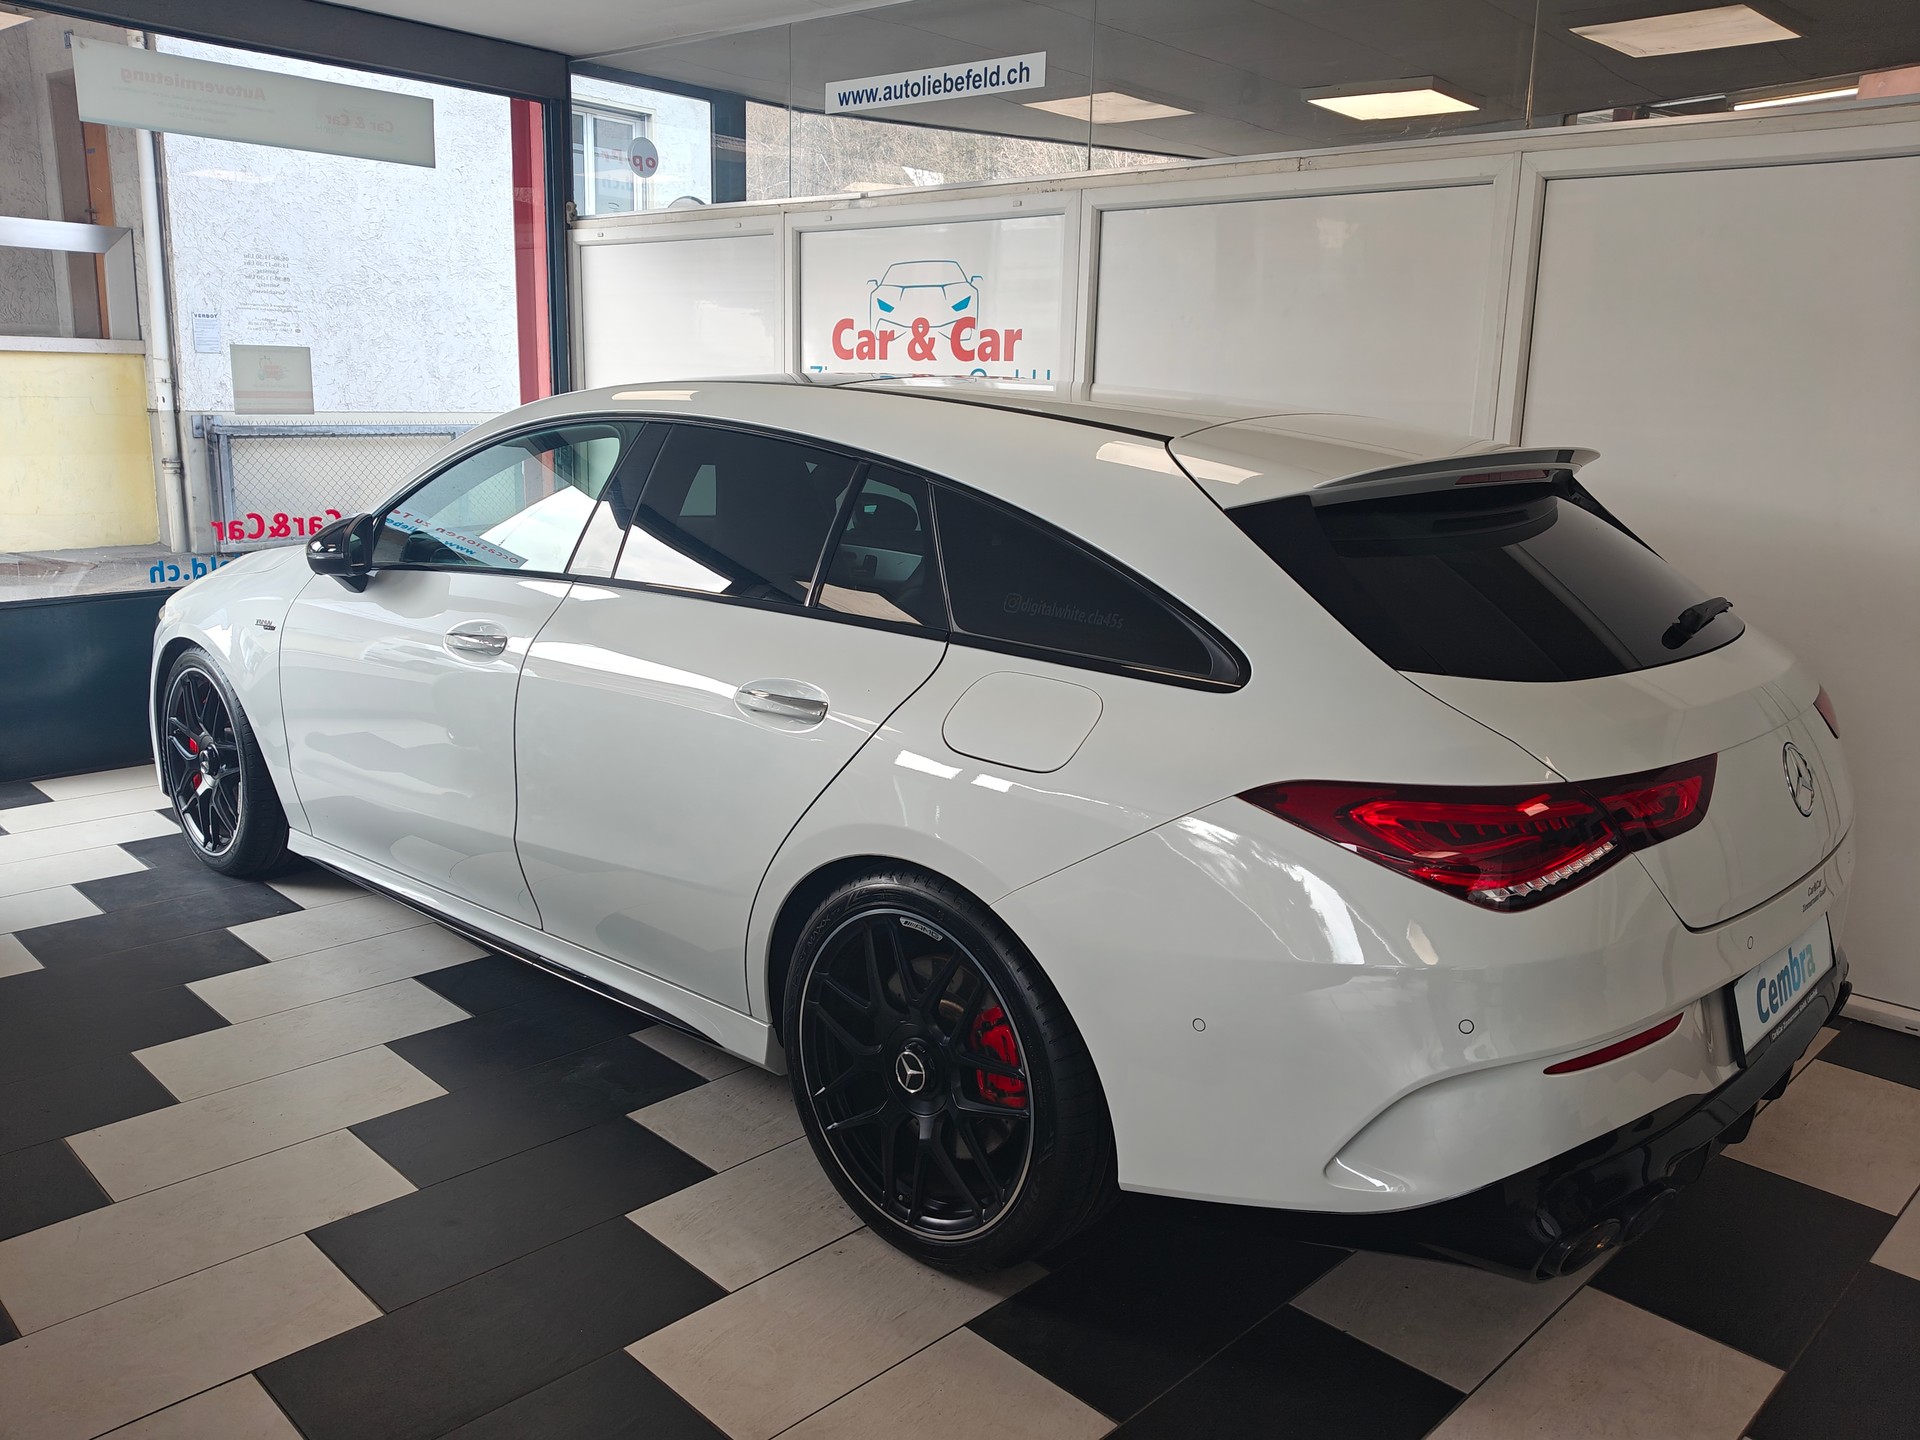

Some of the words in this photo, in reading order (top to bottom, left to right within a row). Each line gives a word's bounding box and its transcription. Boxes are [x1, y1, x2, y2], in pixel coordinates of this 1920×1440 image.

[837, 61, 1030, 107] www.autoliebefeld.ch
[831, 317, 895, 361] Car
[906, 316, 937, 362] &
[949, 316, 1023, 362] Car
[1020, 596, 1125, 630] digitalwhite.cla45s
[1755, 943, 1816, 1024] Cembra
